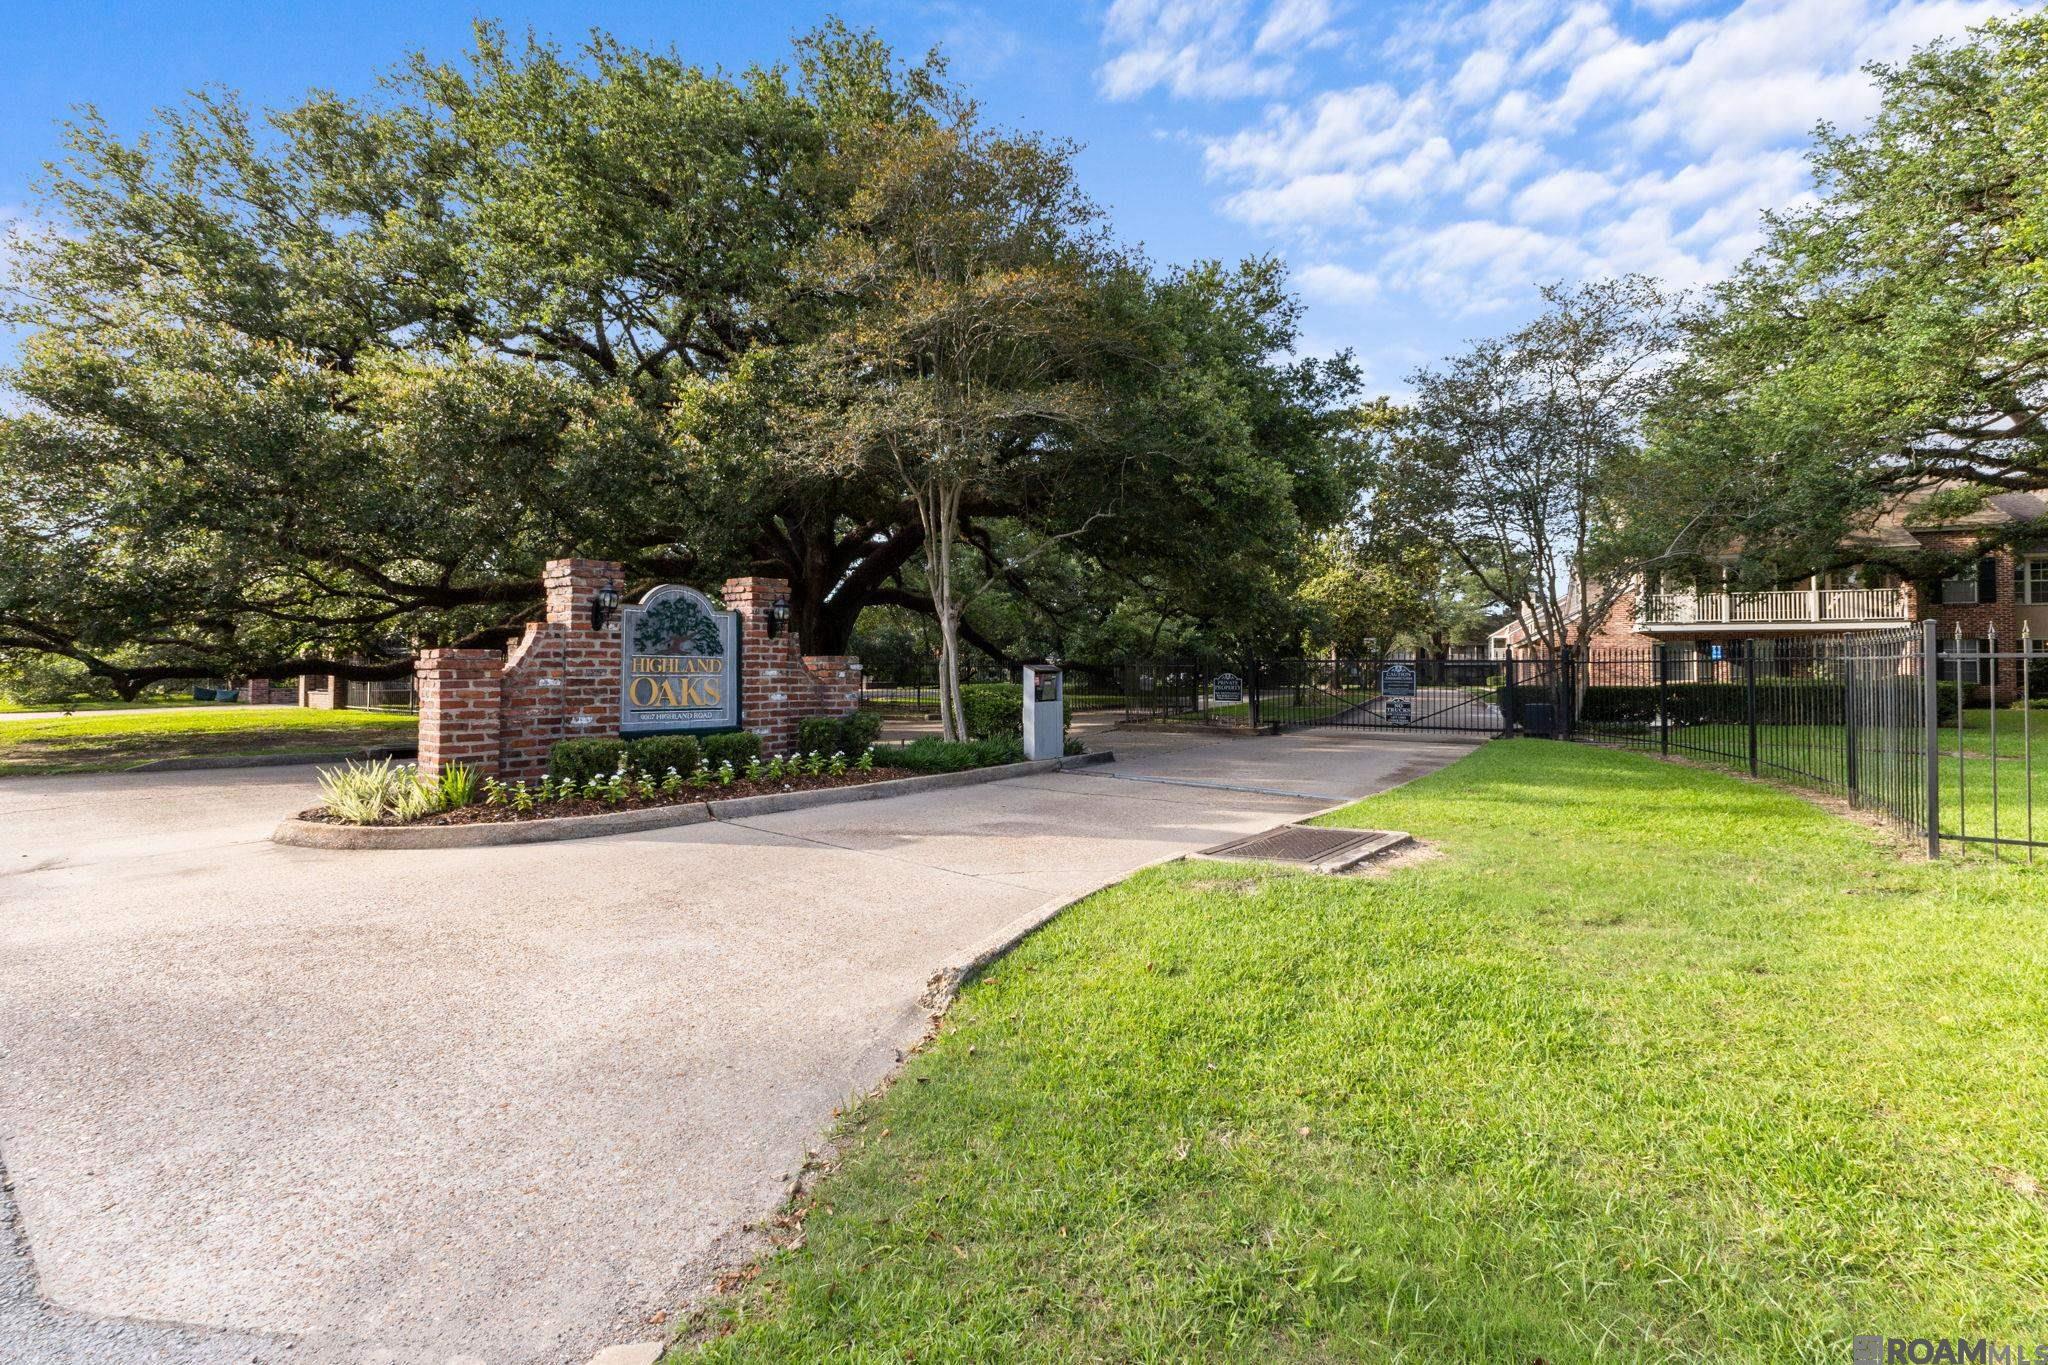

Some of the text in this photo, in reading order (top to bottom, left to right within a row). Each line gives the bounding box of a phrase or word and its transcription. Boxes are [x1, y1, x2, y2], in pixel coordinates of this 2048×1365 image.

[632, 658, 721, 672] HIGHLAND
[629, 676, 721, 708] OAKS
[656, 712, 693, 720] HIGHLAND
[693, 711, 713, 719] ROAD
